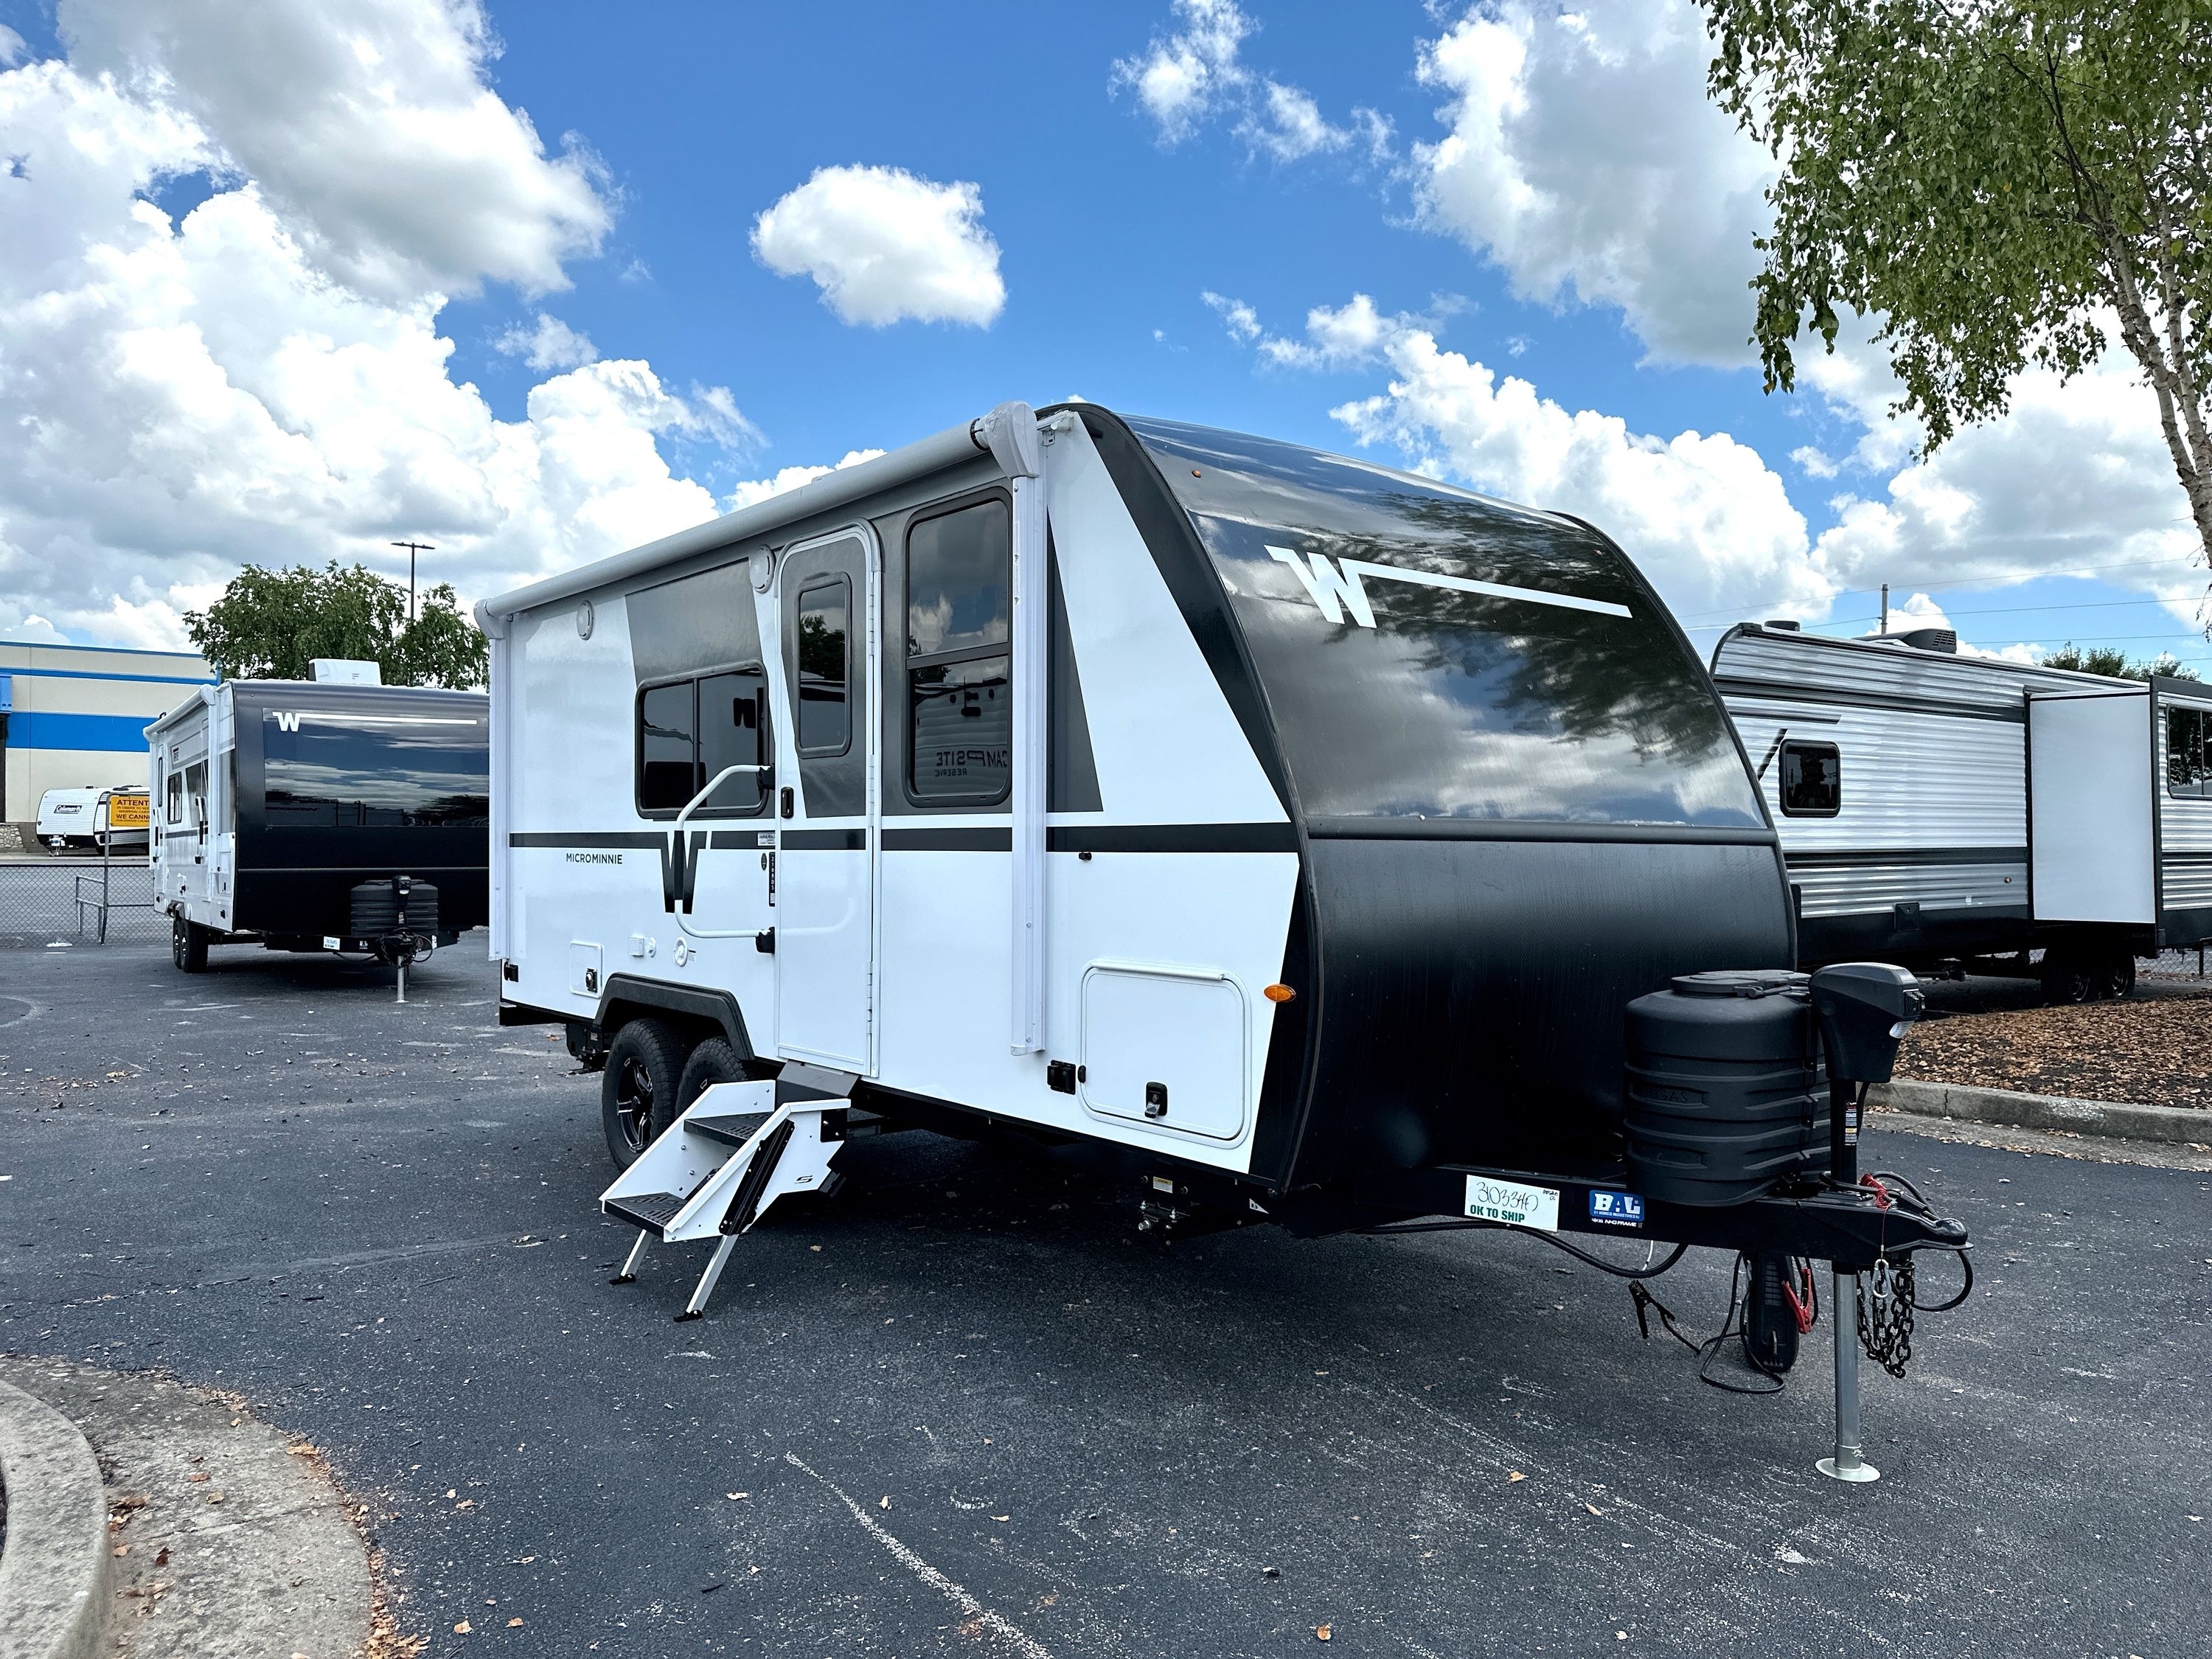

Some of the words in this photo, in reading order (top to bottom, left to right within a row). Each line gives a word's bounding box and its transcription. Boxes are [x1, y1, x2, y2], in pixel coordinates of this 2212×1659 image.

[566, 852, 623, 865] MICROMINNIE
[1658, 1088, 1688, 1103] GAS
[1470, 1204, 1484, 1216] OK
[1486, 1207, 1498, 1219] TO
[1501, 1210, 1526, 1223] SHIP
